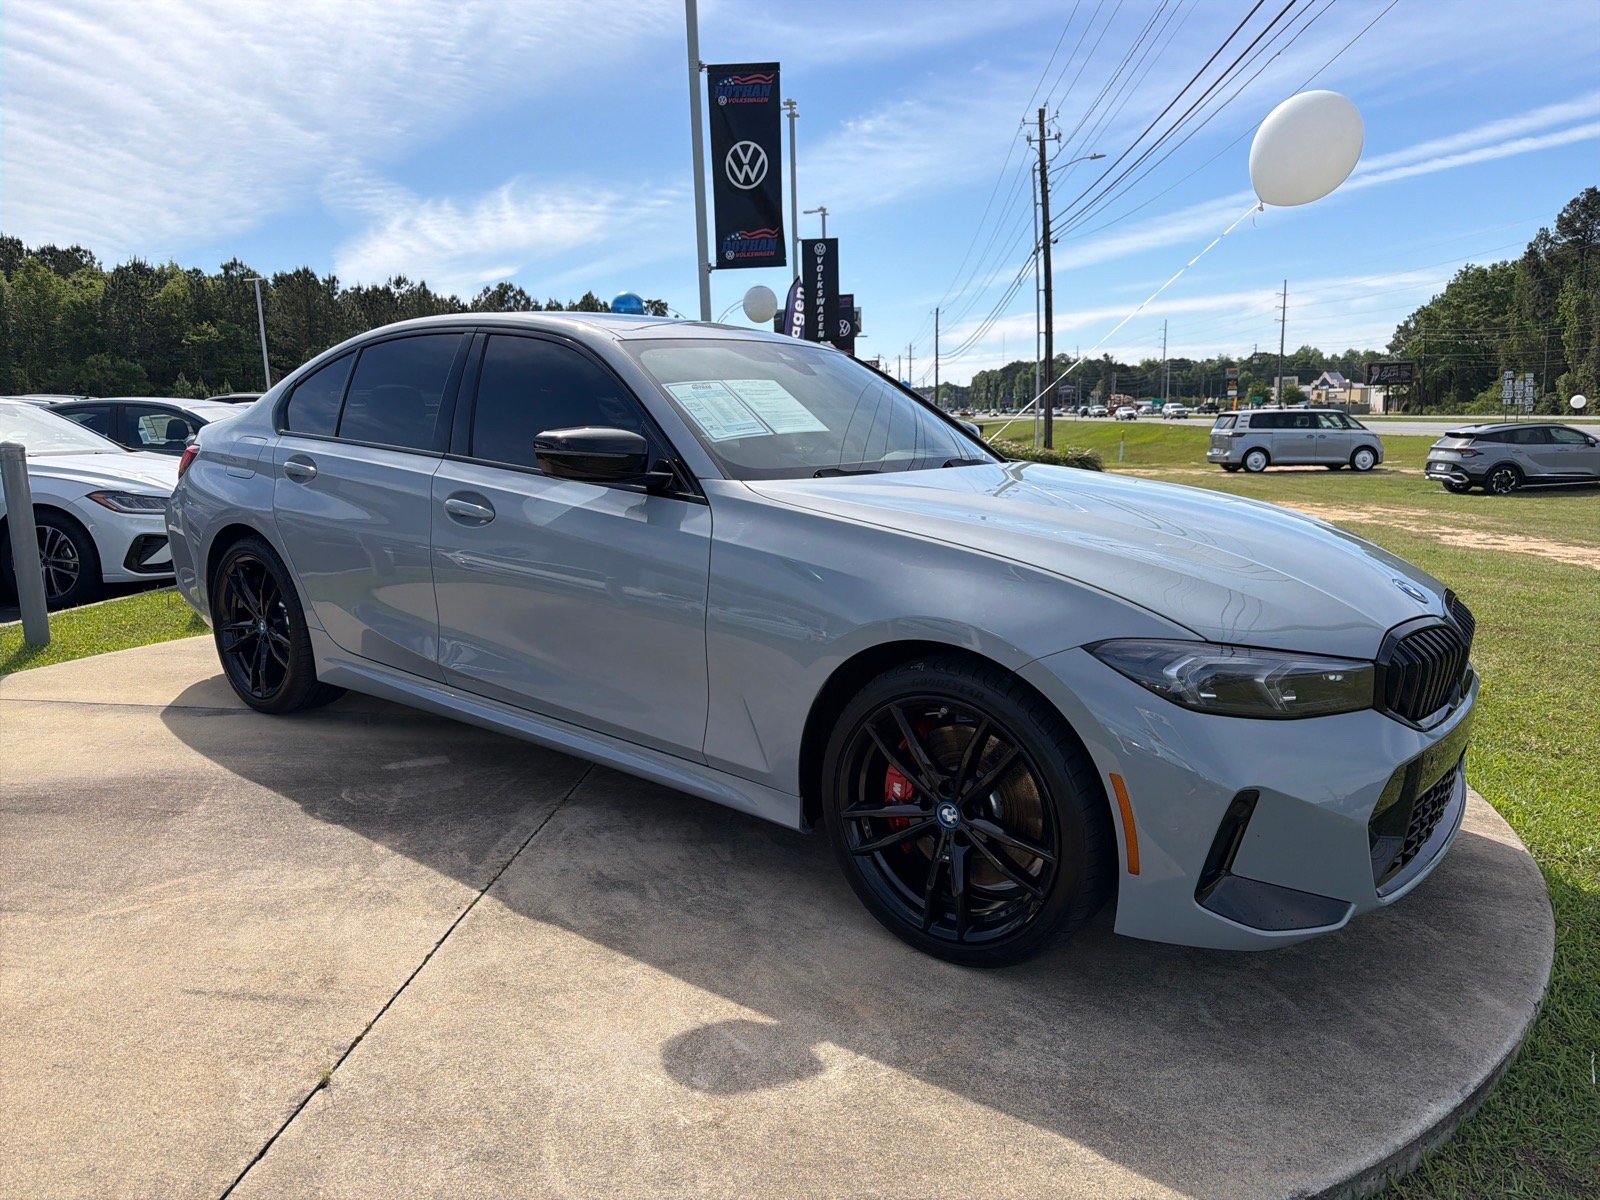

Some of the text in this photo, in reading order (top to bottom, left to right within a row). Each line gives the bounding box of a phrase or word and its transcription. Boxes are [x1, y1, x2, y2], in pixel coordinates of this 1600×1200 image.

[715, 84, 772, 97] DOTHAN
[722, 239, 778, 252] DOTHAN
[815, 257, 825, 338] VOLKSWAGEN
